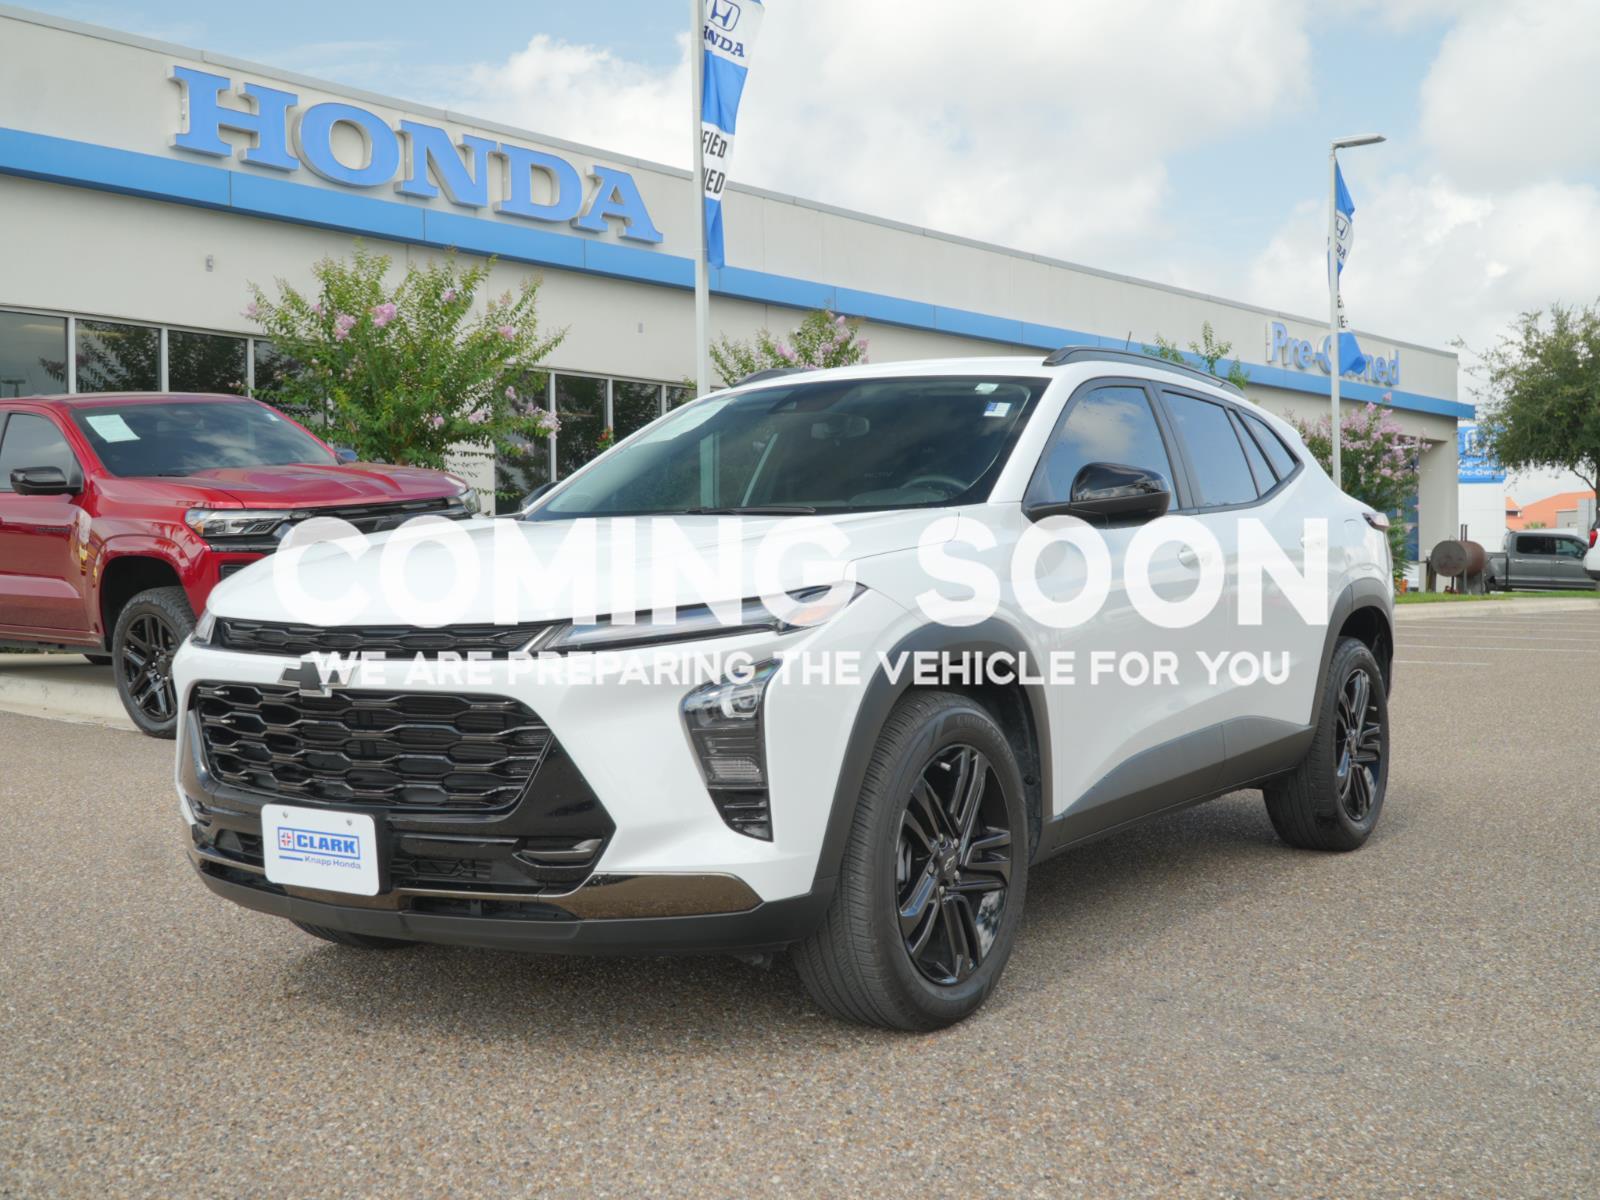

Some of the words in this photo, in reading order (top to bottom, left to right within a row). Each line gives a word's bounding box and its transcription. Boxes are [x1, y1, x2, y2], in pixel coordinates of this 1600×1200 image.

[168, 65, 664, 244] HONDA
[1266, 321, 1400, 386] Pre-ned
[296, 834, 356, 853] CLARK
[304, 856, 332, 867] Knapp
[333, 859, 361, 870] Honda
